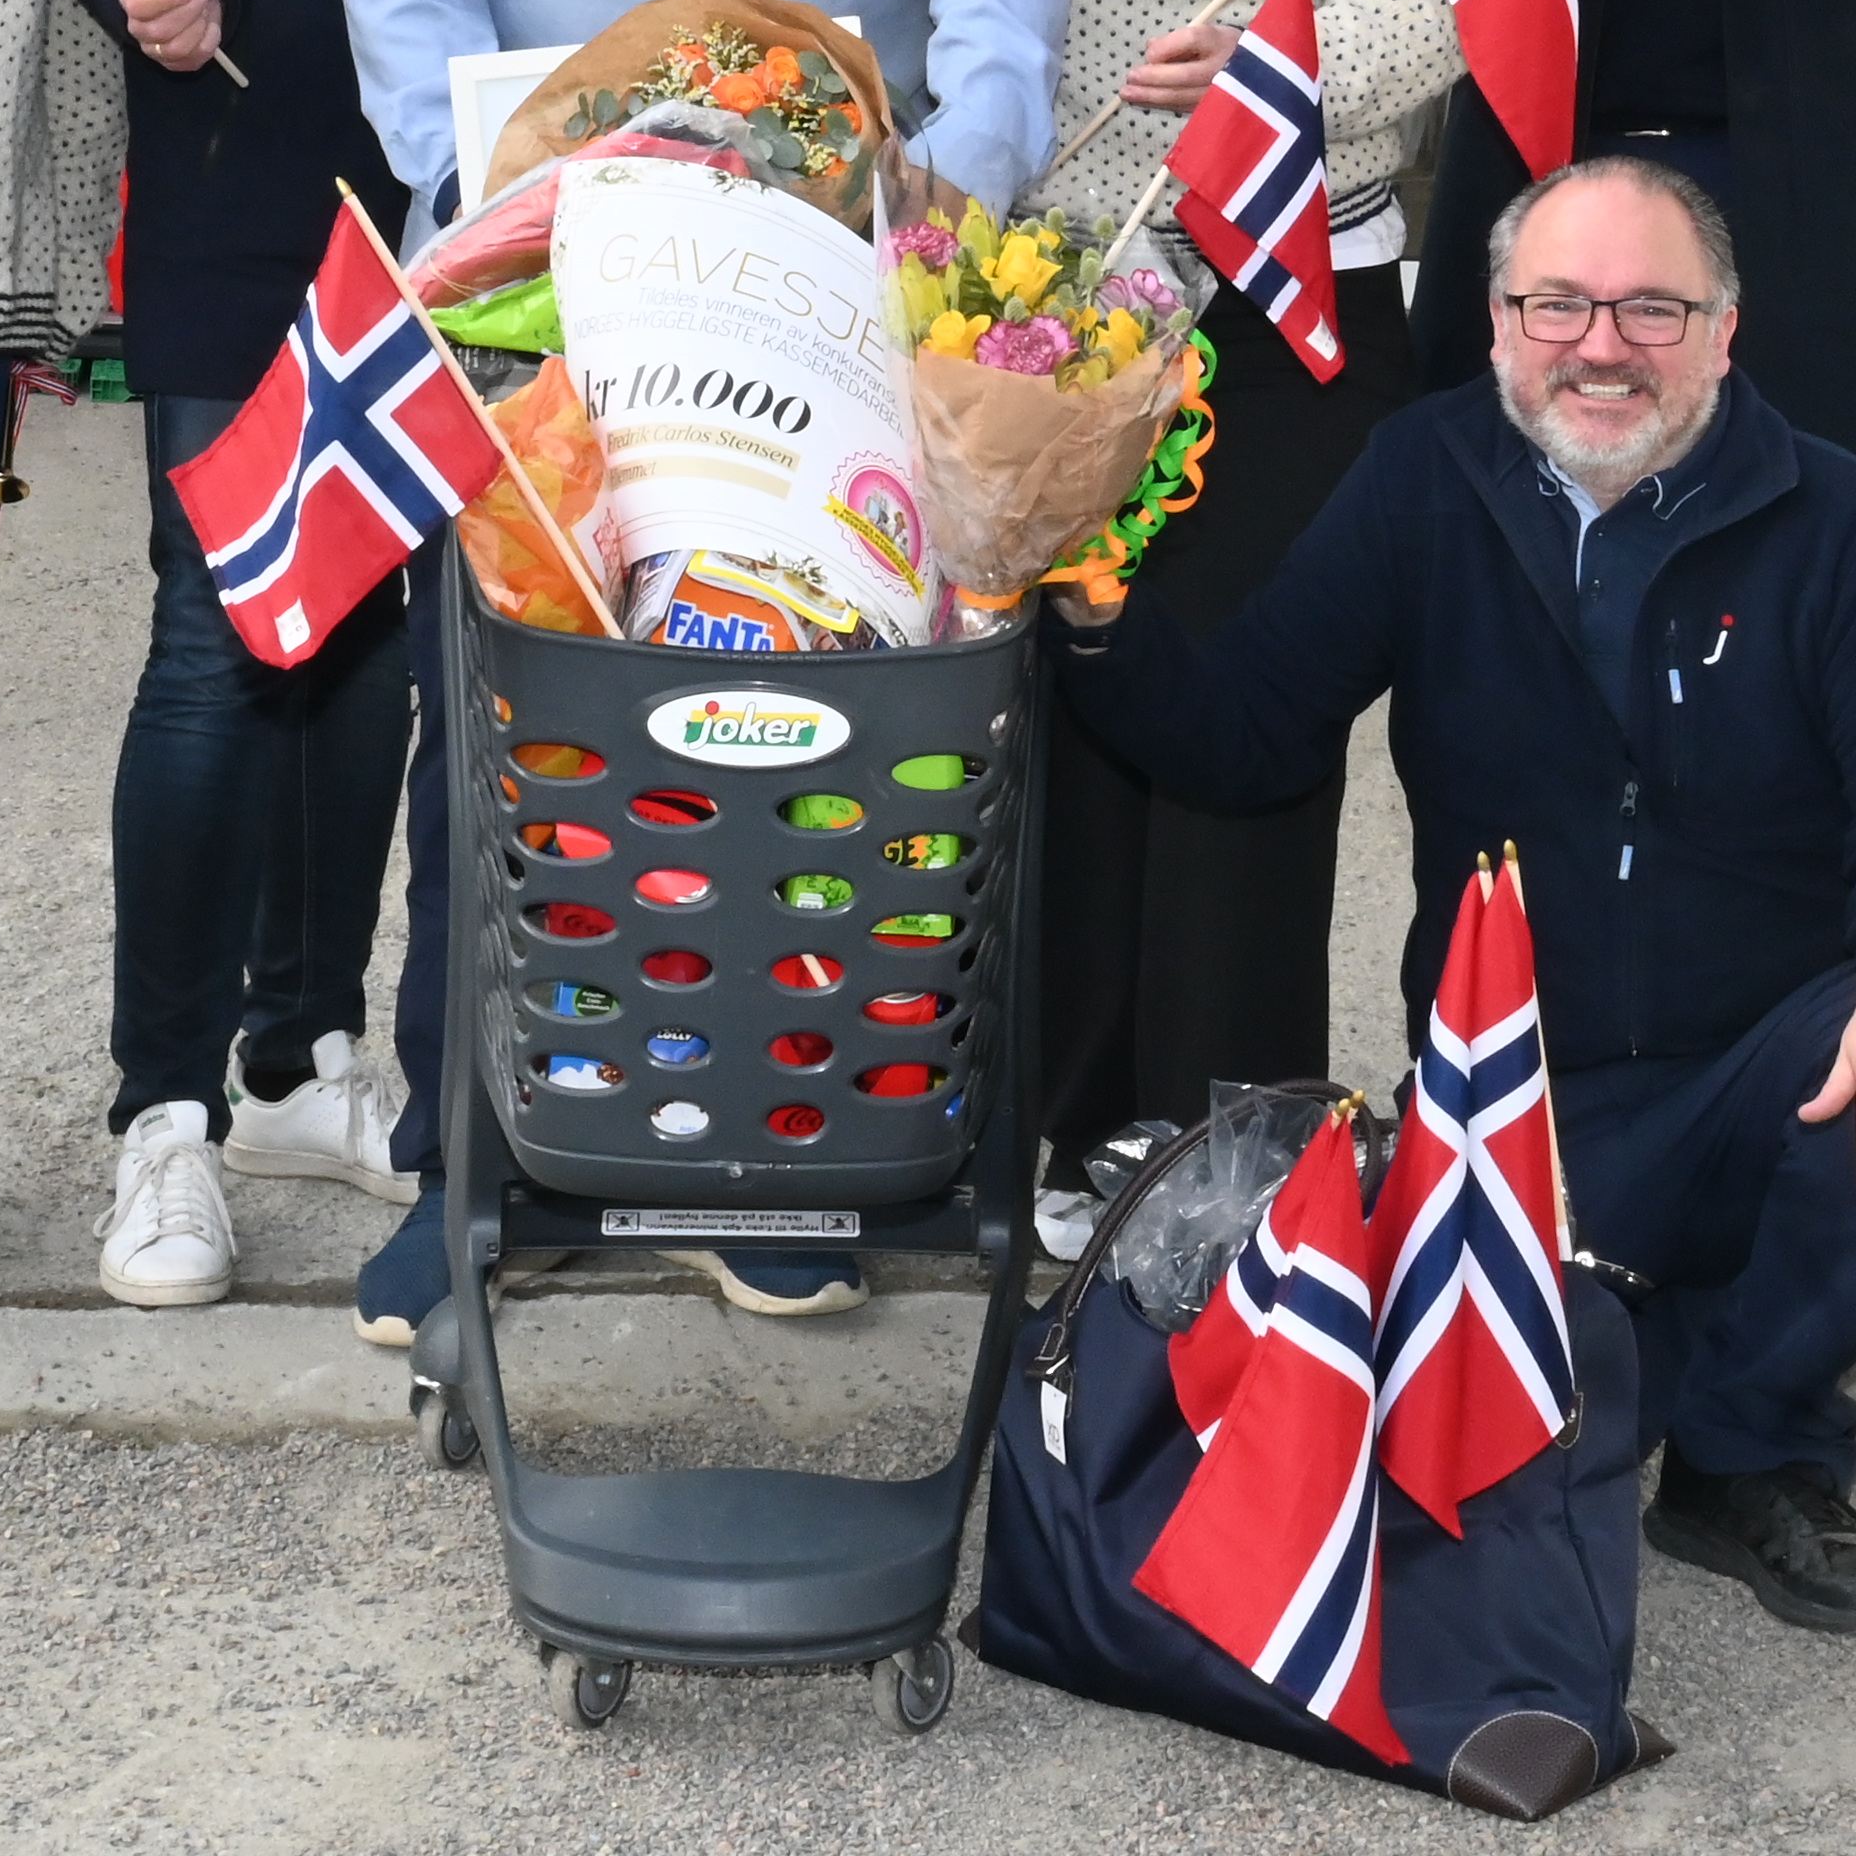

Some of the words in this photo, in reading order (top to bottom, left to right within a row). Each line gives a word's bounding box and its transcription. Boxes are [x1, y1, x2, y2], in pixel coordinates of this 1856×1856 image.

[574, 311, 625, 341] NORGES
[627, 310, 755, 345] HYGGELIGSTE
[638, 287, 699, 309] Tildeles
[705, 295, 782, 331] vinneren
[786, 324, 809, 342] av
[812, 333, 898, 408] konkurrans
[585, 369, 617, 423] kr
[623, 362, 812, 434] 10.000
[606, 425, 648, 452] Fredrik
[653, 423, 713, 444] Carlos
[715, 430, 795, 468] Stensen
[666, 602, 772, 651] FANTA
[687, 700, 812, 751] joker
